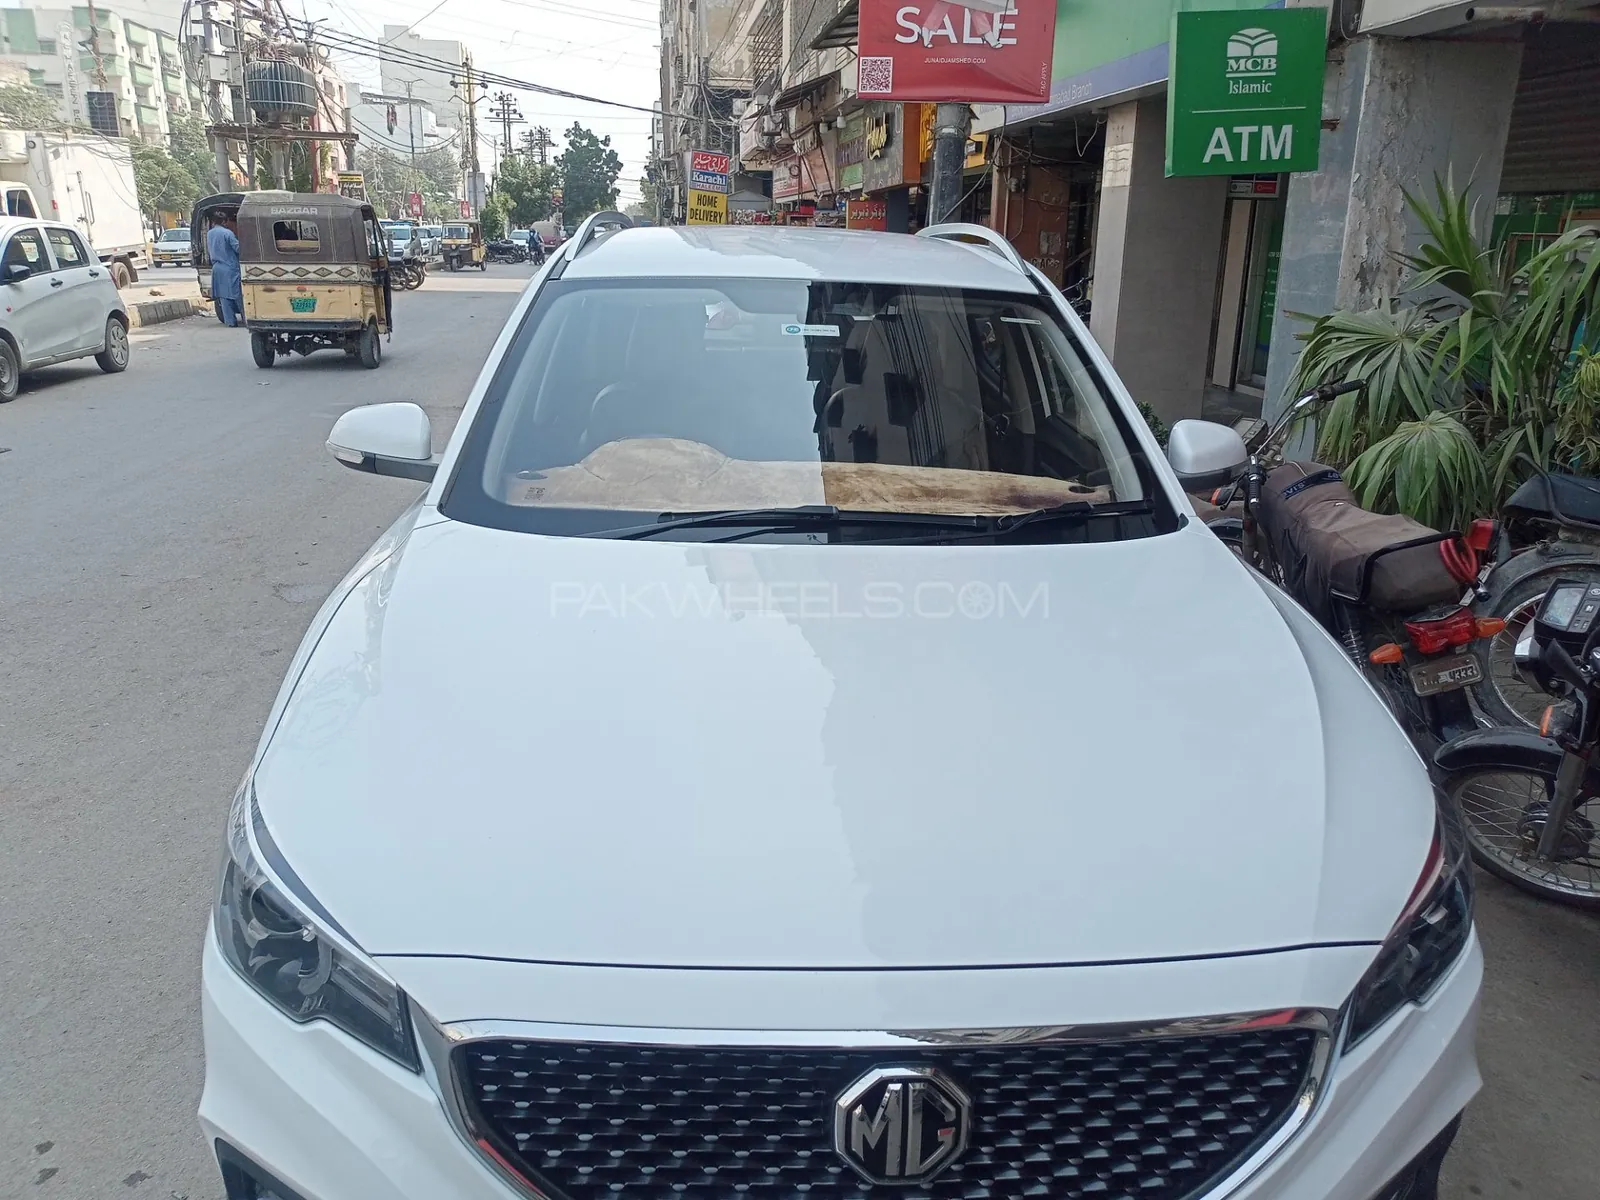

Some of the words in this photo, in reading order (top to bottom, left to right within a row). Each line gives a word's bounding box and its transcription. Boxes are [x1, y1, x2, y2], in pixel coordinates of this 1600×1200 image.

[895, 7, 1018, 45] SALE
[1226, 57, 1277, 72] MCB
[1228, 80, 1272, 95] Islamic
[1202, 124, 1293, 164] ATM
[707, 157, 728, 172] کراچی
[692, 171, 726, 186] Karachi
[696, 194, 718, 208] HOME
[689, 207, 724, 224] DELIVERY
[851, 1083, 956, 1176] MG
